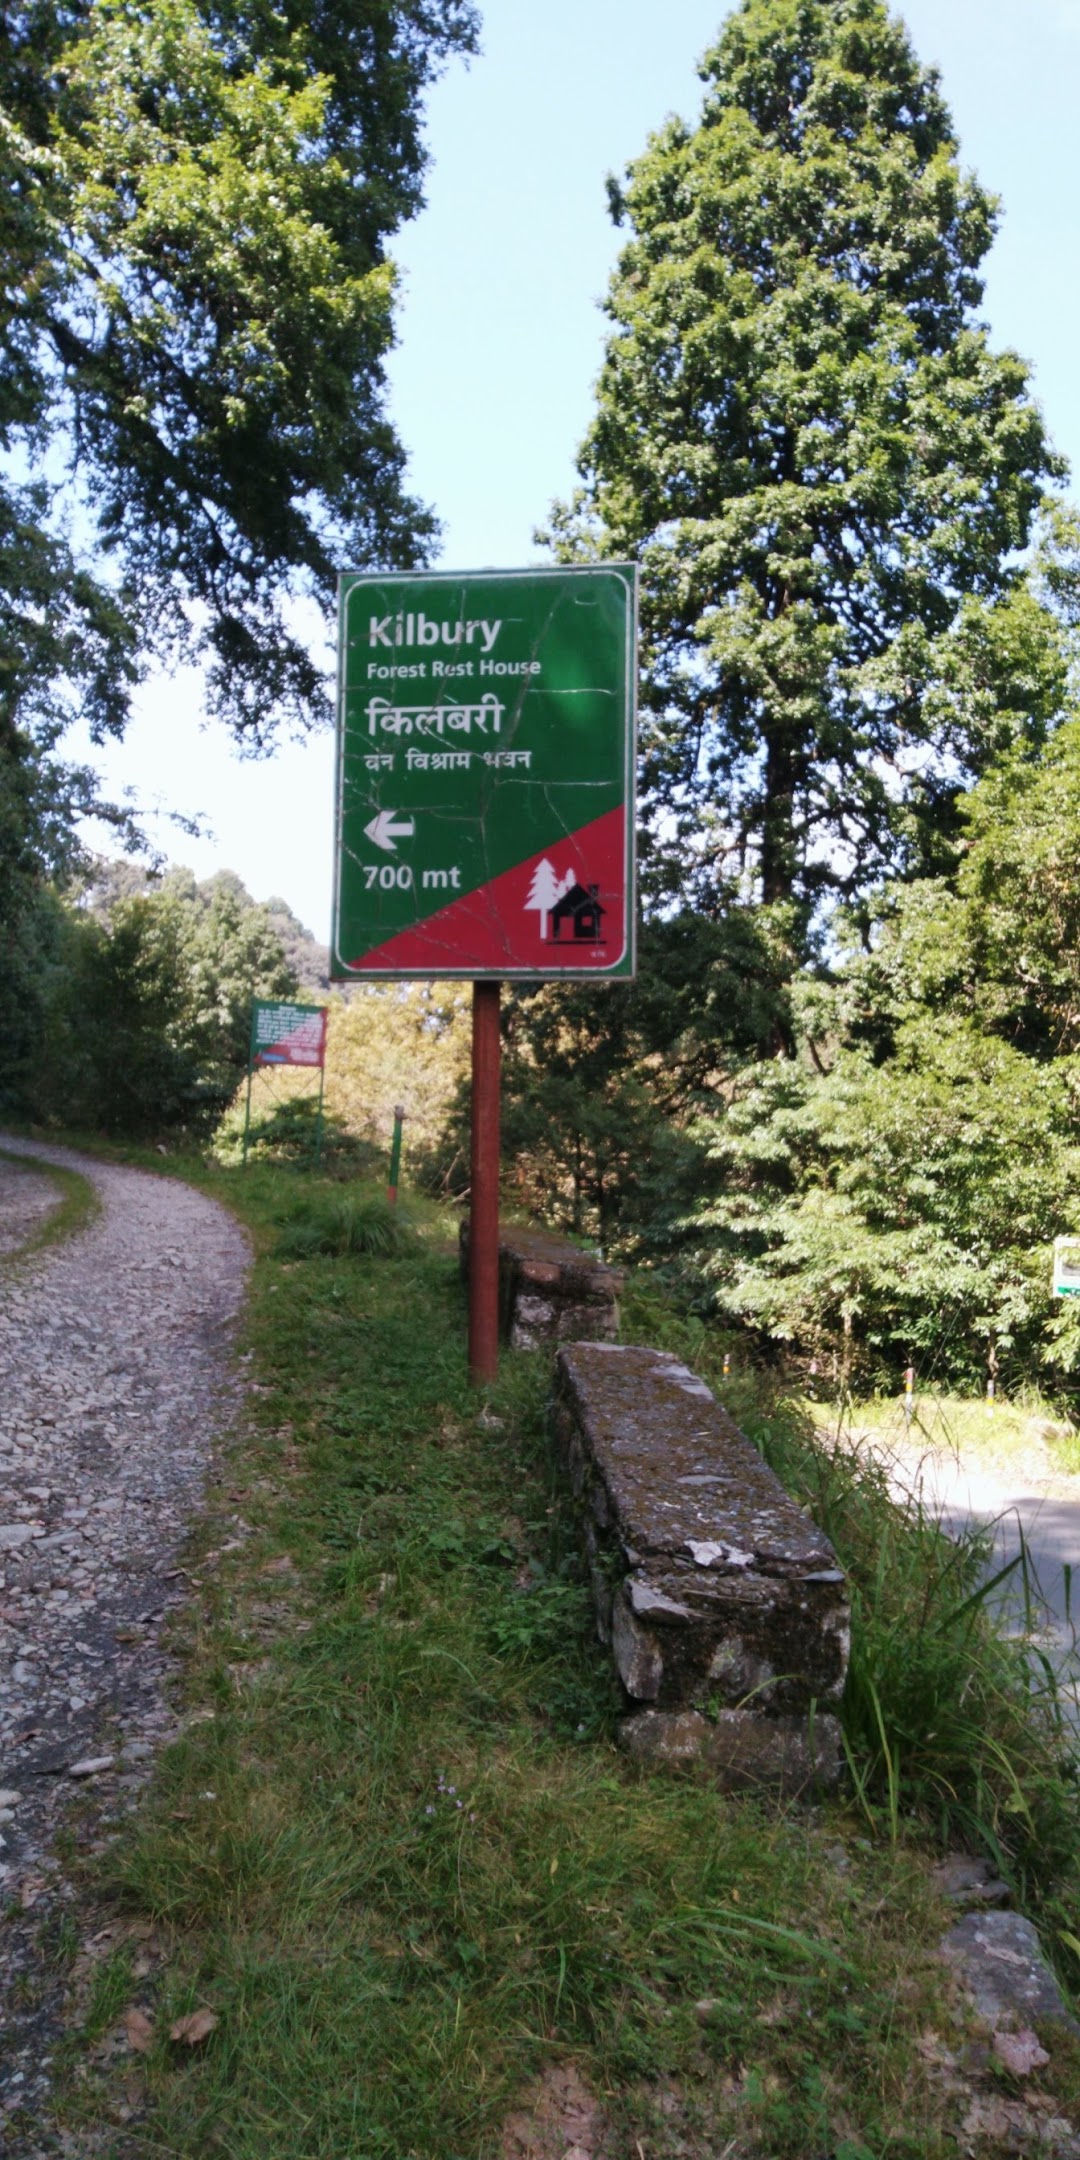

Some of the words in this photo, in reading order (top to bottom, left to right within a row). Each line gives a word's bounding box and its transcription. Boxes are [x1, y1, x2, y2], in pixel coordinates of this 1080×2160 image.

[369, 613, 502, 651] Kilbury
[367, 662, 426, 679] Forest
[432, 660, 474, 678] Rest
[479, 659, 542, 676] House
[364, 693, 505, 736] किलबरी
[364, 753, 394, 772] वन
[405, 748, 471, 771] विश्राम
[483, 751, 532, 769] भवन
[363, 866, 413, 889] 700
[422, 866, 461, 889] mt
